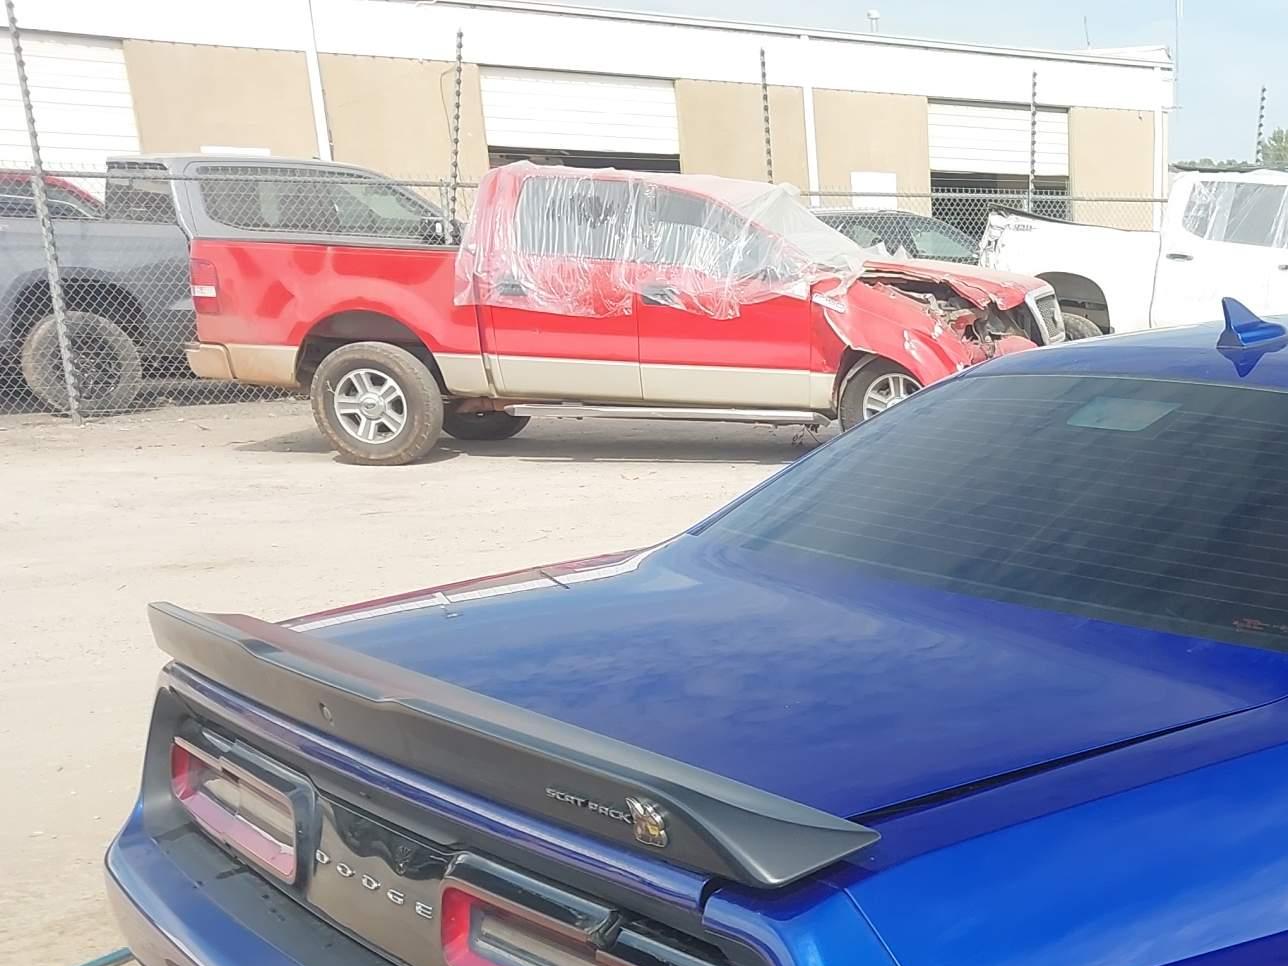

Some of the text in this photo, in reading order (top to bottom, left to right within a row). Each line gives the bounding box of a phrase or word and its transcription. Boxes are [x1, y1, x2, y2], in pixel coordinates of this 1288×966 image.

[545, 787, 632, 824] SCAT PACK
[315, 849, 433, 919] DODGE
